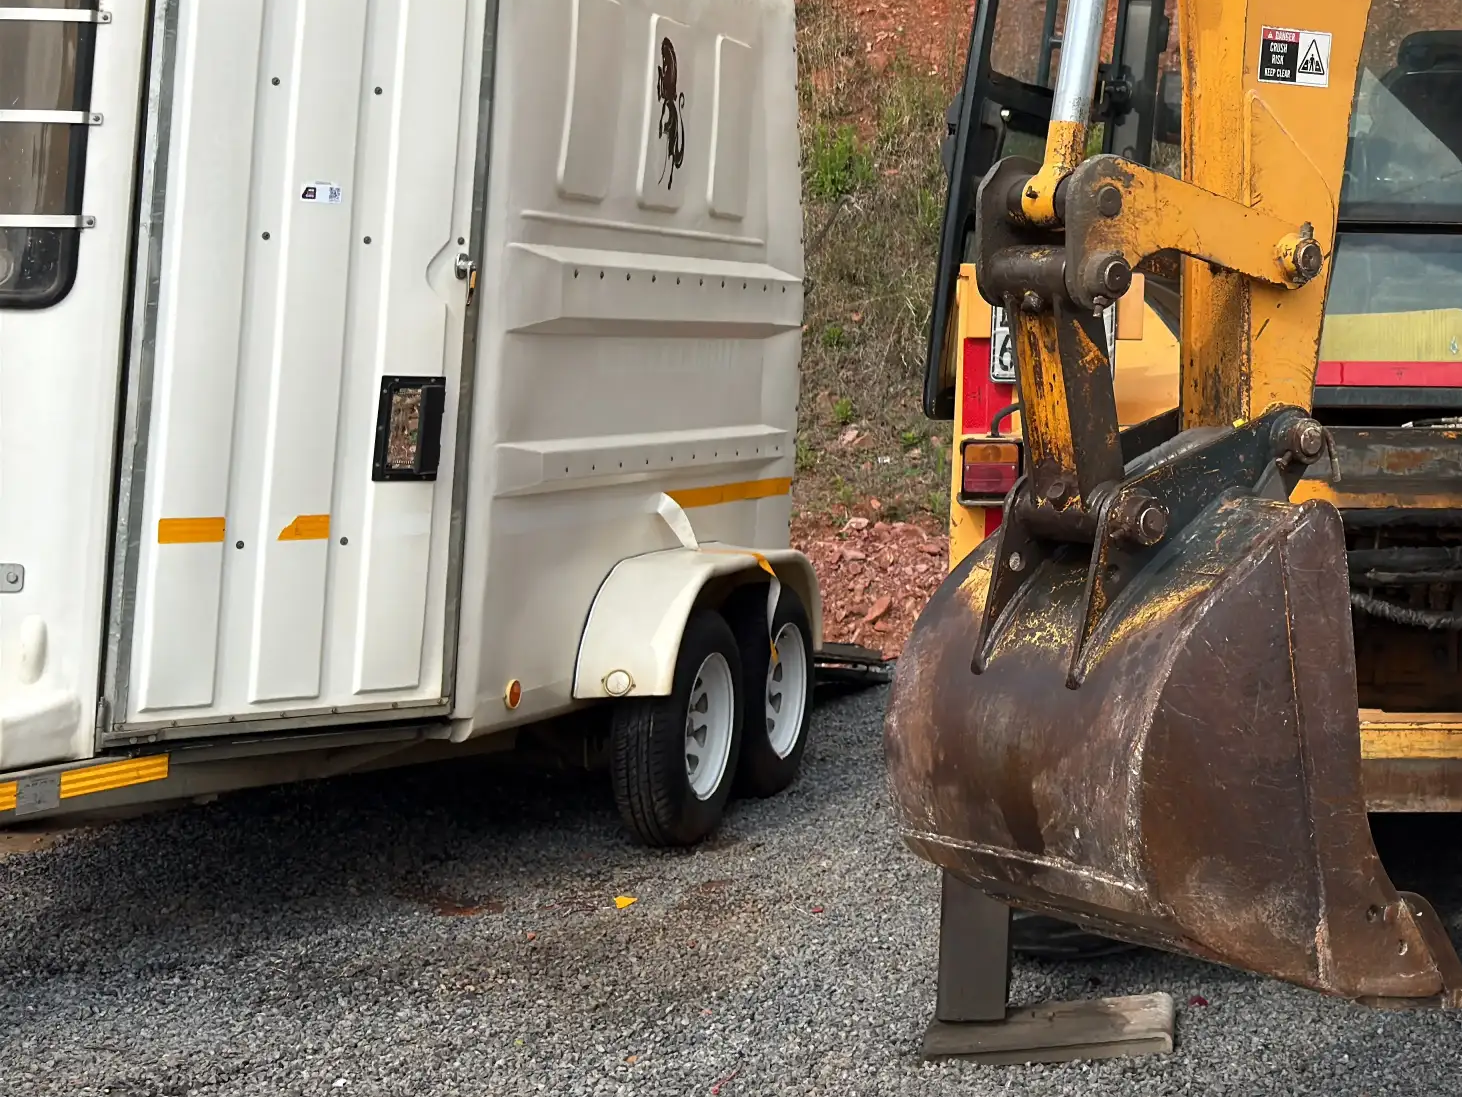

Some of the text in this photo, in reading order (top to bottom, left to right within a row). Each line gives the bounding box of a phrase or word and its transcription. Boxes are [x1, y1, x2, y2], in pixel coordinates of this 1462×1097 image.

[1275, 30, 1296, 43] DANGER
[1269, 42, 1288, 53] CRUSH
[1271, 54, 1285, 65] RISK
[1264, 67, 1291, 78] KEEP CLEAR
